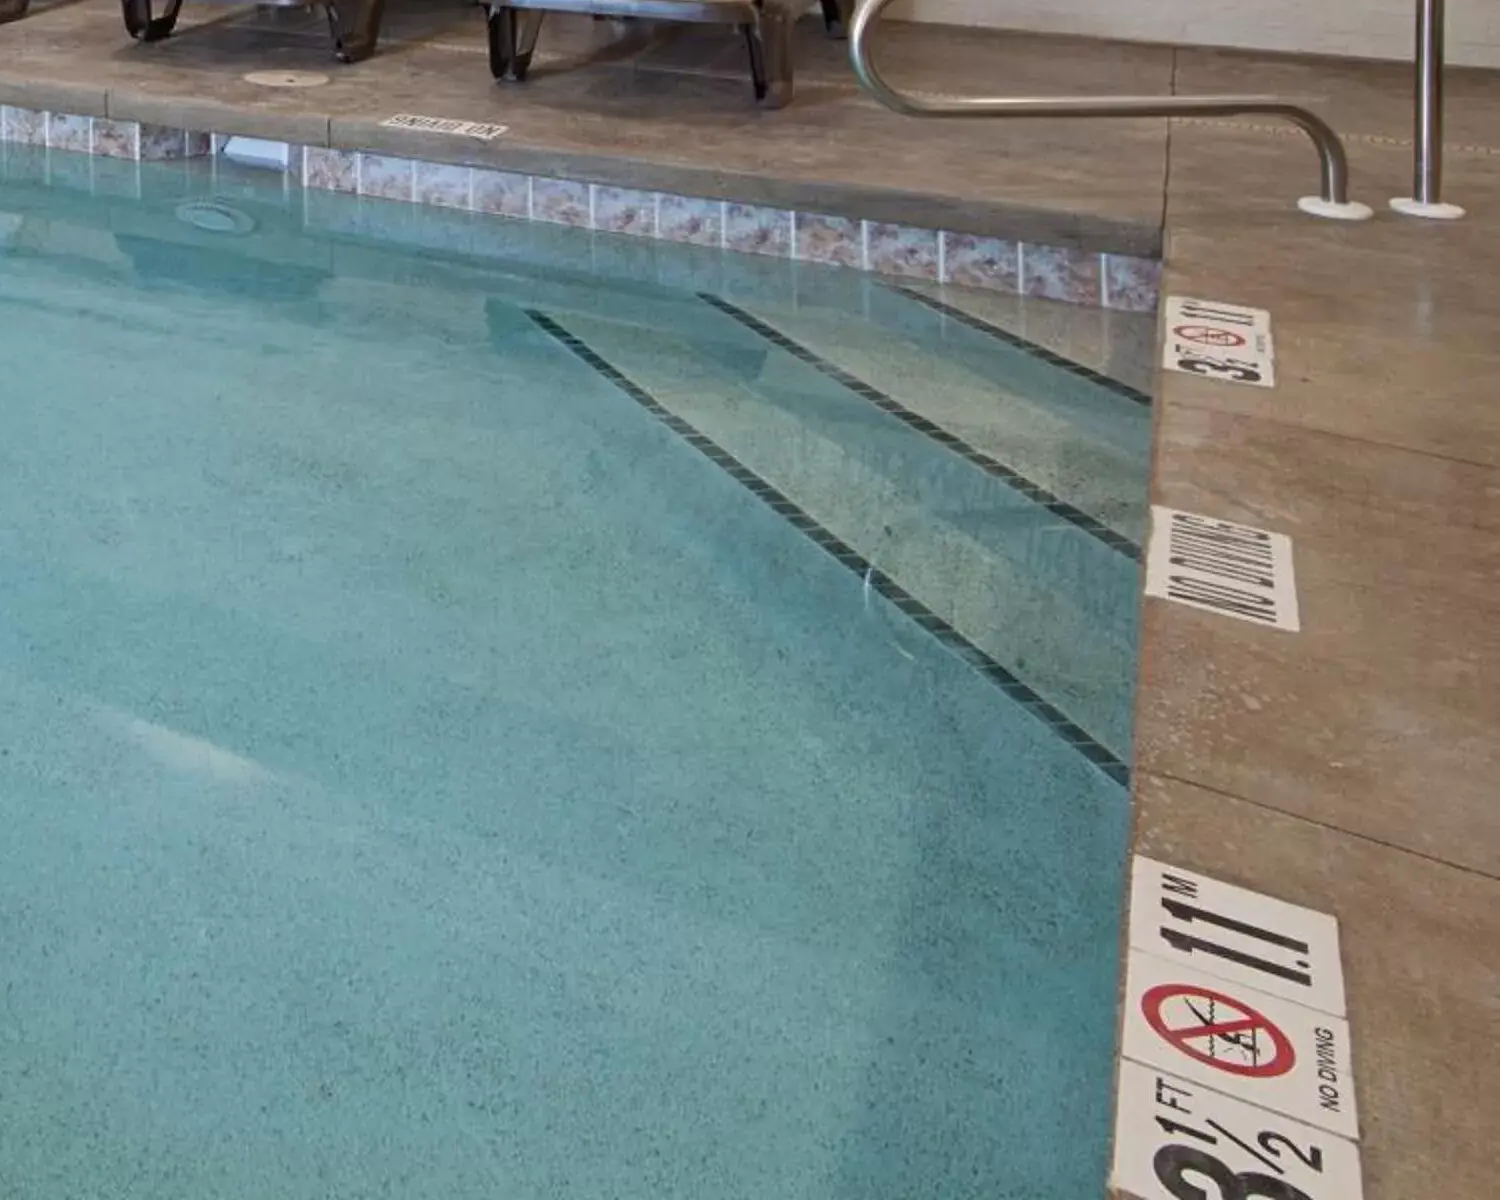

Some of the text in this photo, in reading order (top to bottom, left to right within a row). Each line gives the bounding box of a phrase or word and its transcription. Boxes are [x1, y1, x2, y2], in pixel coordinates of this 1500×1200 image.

[1159, 872, 1312, 987] 1.1 M
[1155, 1077, 1194, 1115] FT
[1312, 1026, 1342, 1113] NO DIVING
